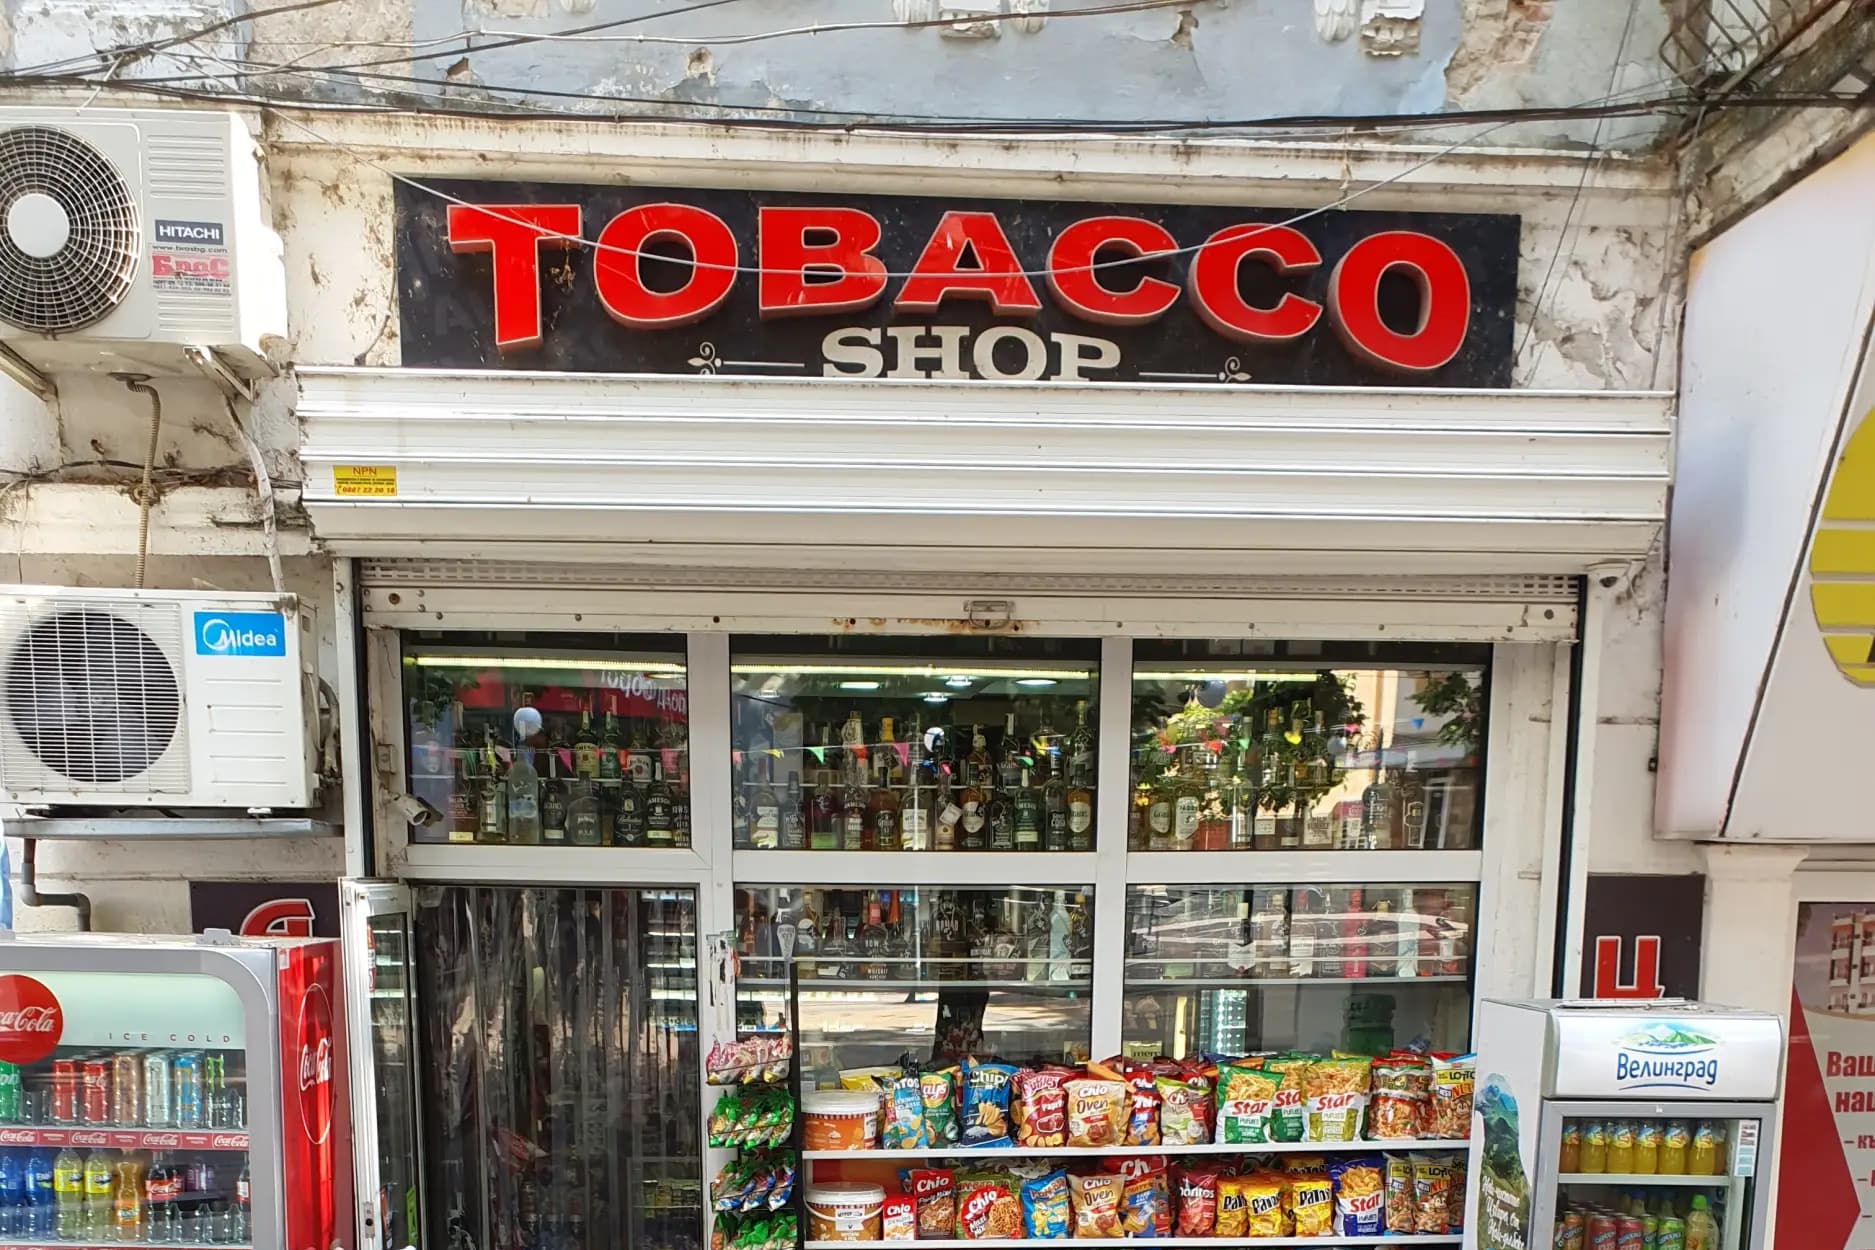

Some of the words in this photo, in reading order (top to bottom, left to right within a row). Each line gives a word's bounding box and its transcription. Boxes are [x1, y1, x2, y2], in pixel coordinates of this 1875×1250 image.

[160, 225, 220, 239] HITACHI
[446, 201, 1472, 370] TOBACCO
[821, 325, 1122, 382] SHOP
[353, 467, 376, 475] NPN
[205, 621, 277, 650] Midea
[108, 1032, 148, 1041] ICE
[170, 1034, 231, 1043] COLD
[1616, 1052, 1718, 1085] Велинград
[1077, 1099, 1109, 1114] Oven
[1275, 1090, 1300, 1107] Sta
[1316, 1094, 1355, 1111] Star
[1232, 1101, 1269, 1115] Star
[916, 1177, 950, 1193] Chio
[967, 1190, 998, 1214] Chio
[1084, 1189, 1114, 1206] Oven
[1349, 1193, 1381, 1213] Star
[886, 1203, 911, 1216] Chio
